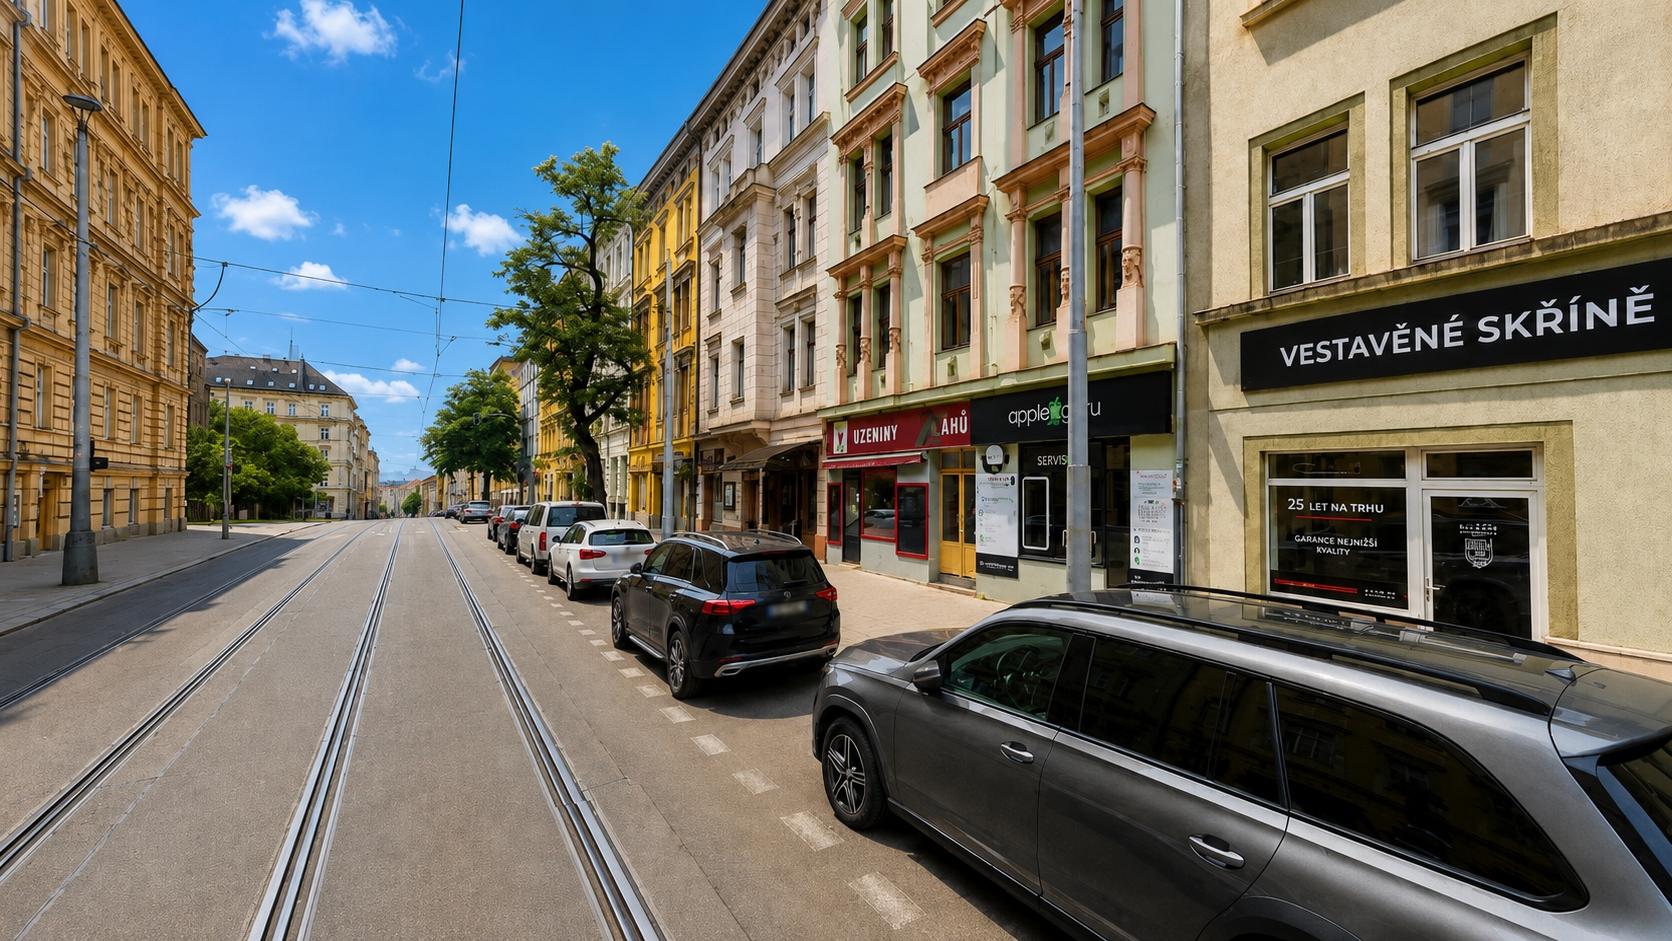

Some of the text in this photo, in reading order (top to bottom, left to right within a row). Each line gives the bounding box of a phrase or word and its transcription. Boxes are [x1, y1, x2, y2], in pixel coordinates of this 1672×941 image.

[1280, 285, 1655, 367] VESTAVĚNÉ SKŘÍNĚ
[1008, 403, 1049, 428] apple
[853, 424, 898, 445] UZENINY
[1037, 454, 1068, 466] SERVIS
[1287, 498, 1384, 513] 25 LET NA TRHU
[1294, 534, 1335, 545] GARANCE
[1316, 546, 1351, 556] KVALITY
